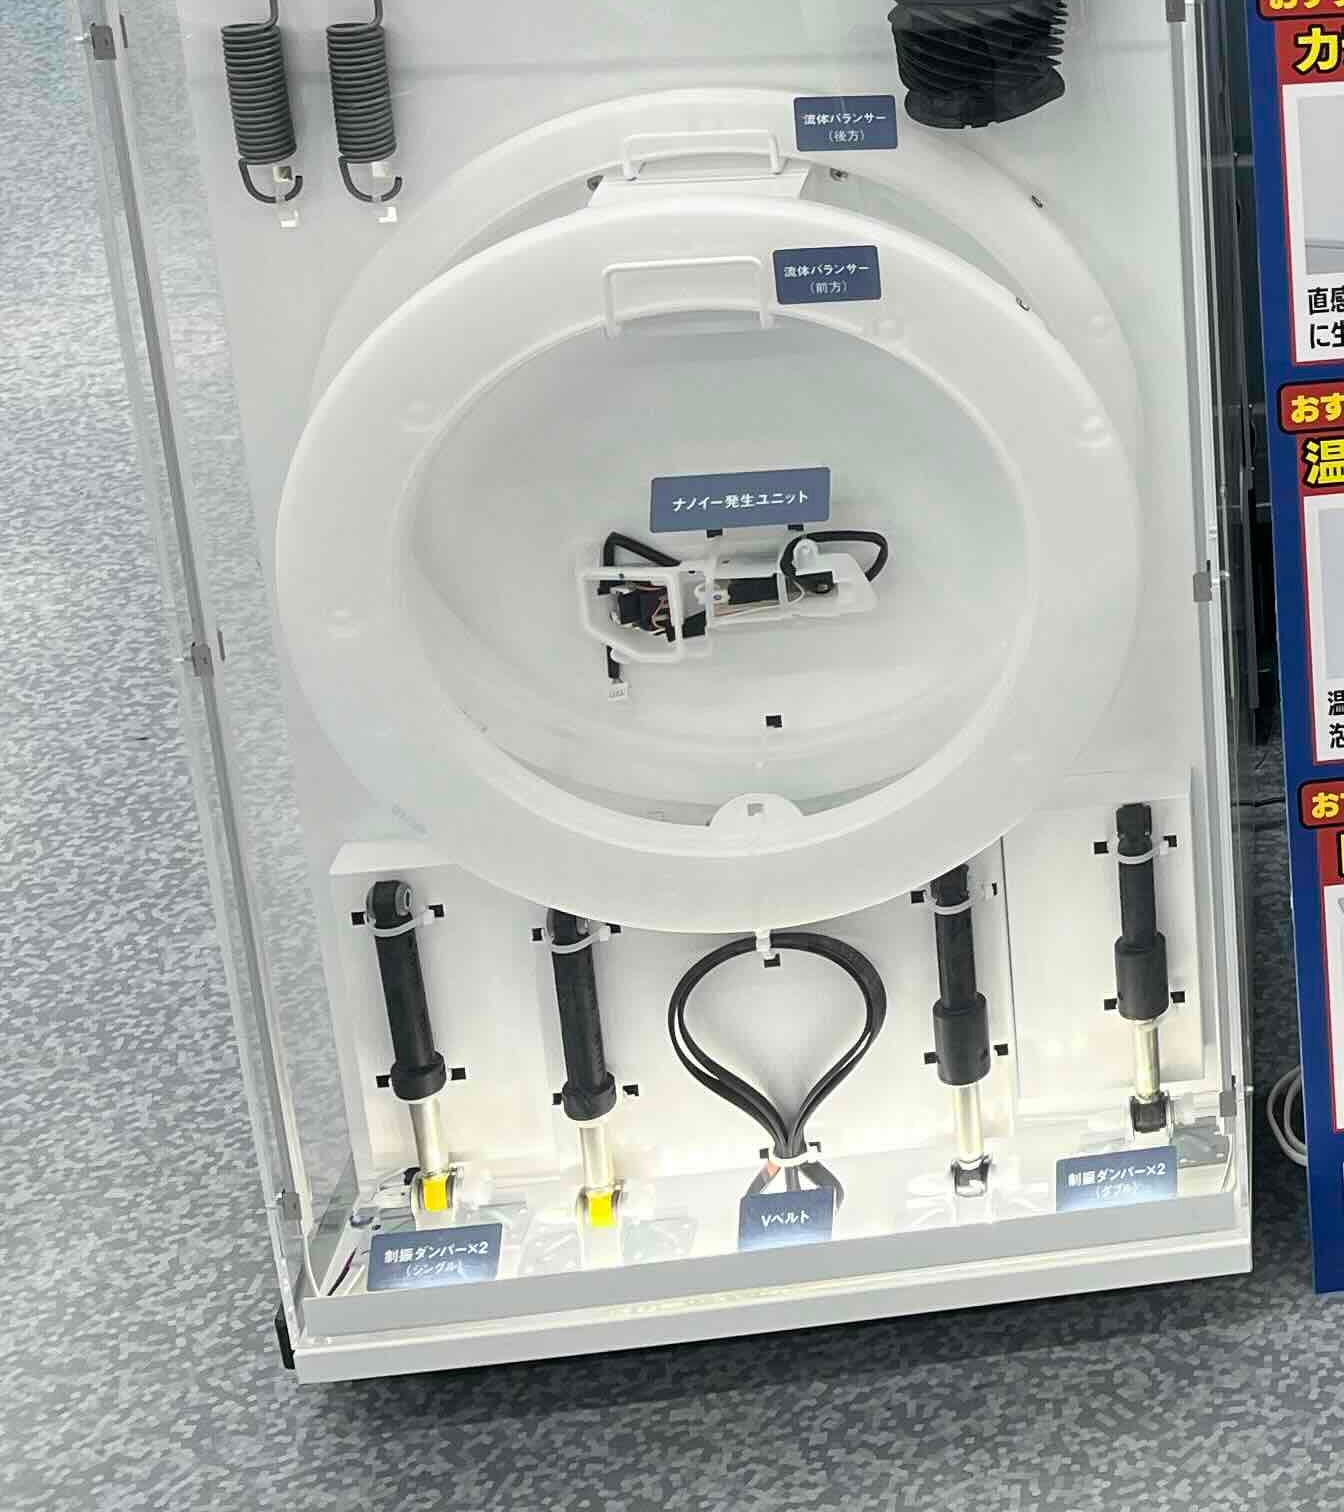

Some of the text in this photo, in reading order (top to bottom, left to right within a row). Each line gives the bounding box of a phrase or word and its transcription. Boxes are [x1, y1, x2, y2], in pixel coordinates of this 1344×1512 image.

[804, 112, 886, 126] 流体バランサー
[783, 262, 869, 278] 流体バランサー
[673, 490, 808, 512] ナノイー発生ユニット
[759, 1209, 811, 1228] Vベルト
